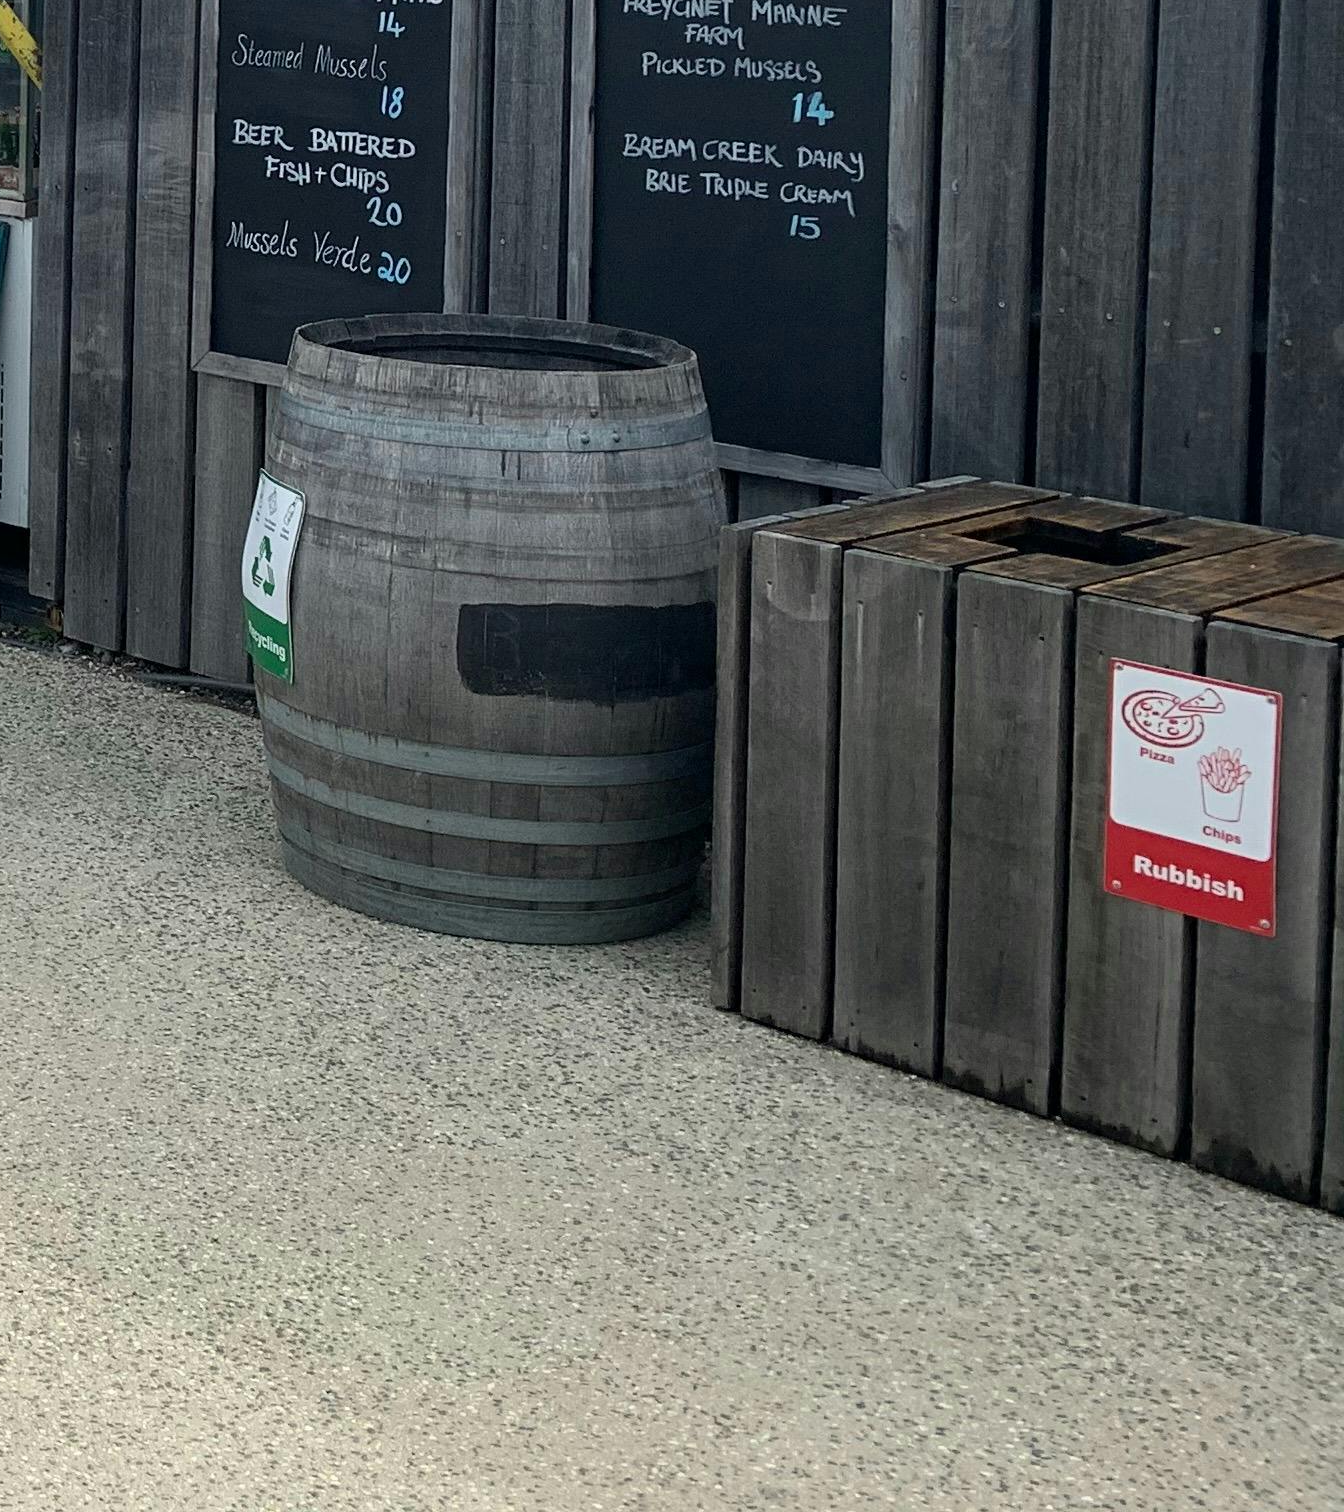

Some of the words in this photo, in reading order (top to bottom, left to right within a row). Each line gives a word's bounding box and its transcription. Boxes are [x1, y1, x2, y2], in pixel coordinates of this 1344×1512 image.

[378, 11, 406, 38] 14
[751, 0, 848, 27] MARINE
[684, 23, 745, 51] FARM
[231, 34, 305, 70] Steamed
[314, 44, 388, 82] Mussels
[641, 51, 726, 77] PICKLED
[734, 56, 823, 84] MUSSELS
[381, 86, 404, 119] 18
[792, 91, 835, 126] 14
[232, 118, 294, 151] BEER
[308, 127, 416, 159] BATTERED
[622, 133, 697, 161] BREAM
[702, 139, 784, 168] CREEK
[797, 145, 865, 182] DAIRY
[645, 168, 693, 193] BRIE
[700, 172, 769, 201] TRIPLE
[779, 182, 856, 218] CREAM
[366, 196, 403, 227] 20
[789, 214, 822, 239] 15
[226, 220, 299, 258] Mussels
[313, 230, 372, 274] Verde
[377, 251, 412, 285] 20
[1139, 747, 1175, 765] Pizza
[1202, 825, 1242, 845] Chips
[1133, 854, 1244, 902] Rubbish
